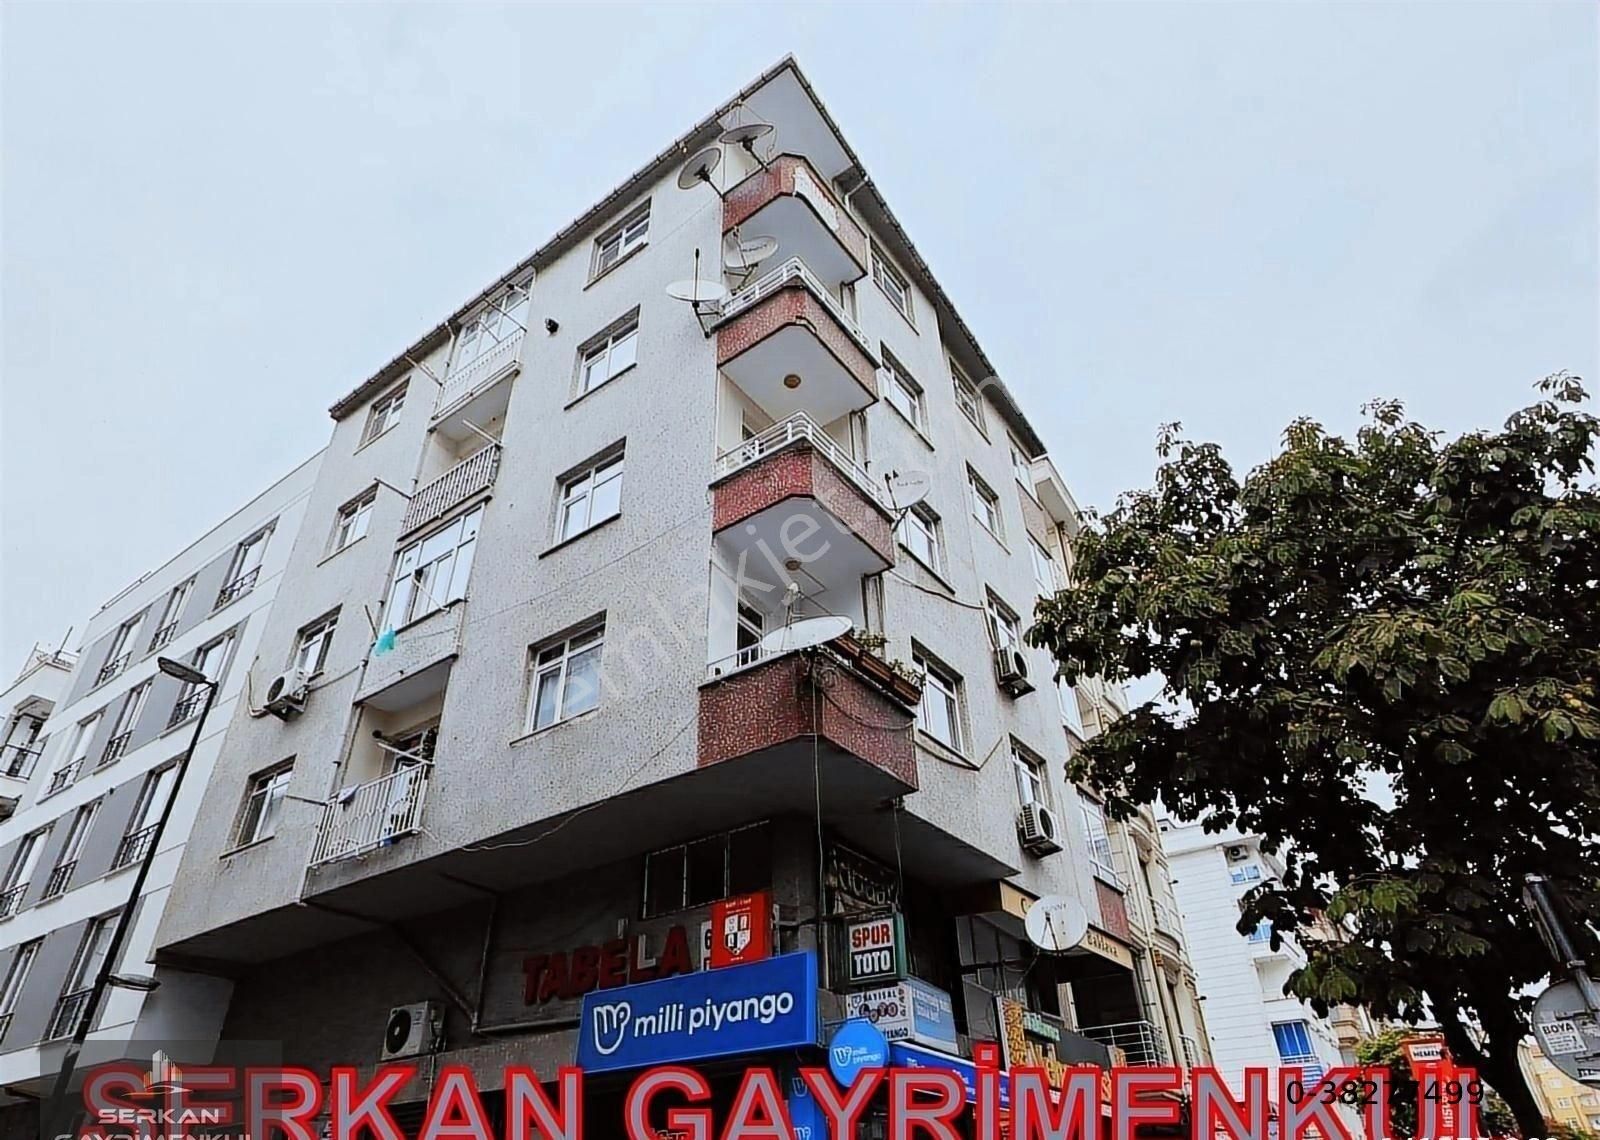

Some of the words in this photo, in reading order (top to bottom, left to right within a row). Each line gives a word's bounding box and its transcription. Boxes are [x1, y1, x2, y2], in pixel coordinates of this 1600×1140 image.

[854, 950, 892, 975] TOTO
[634, 1012, 684, 1038] milli
[688, 991, 794, 1035] piyango
[1542, 1023, 1574, 1035] BOYA
